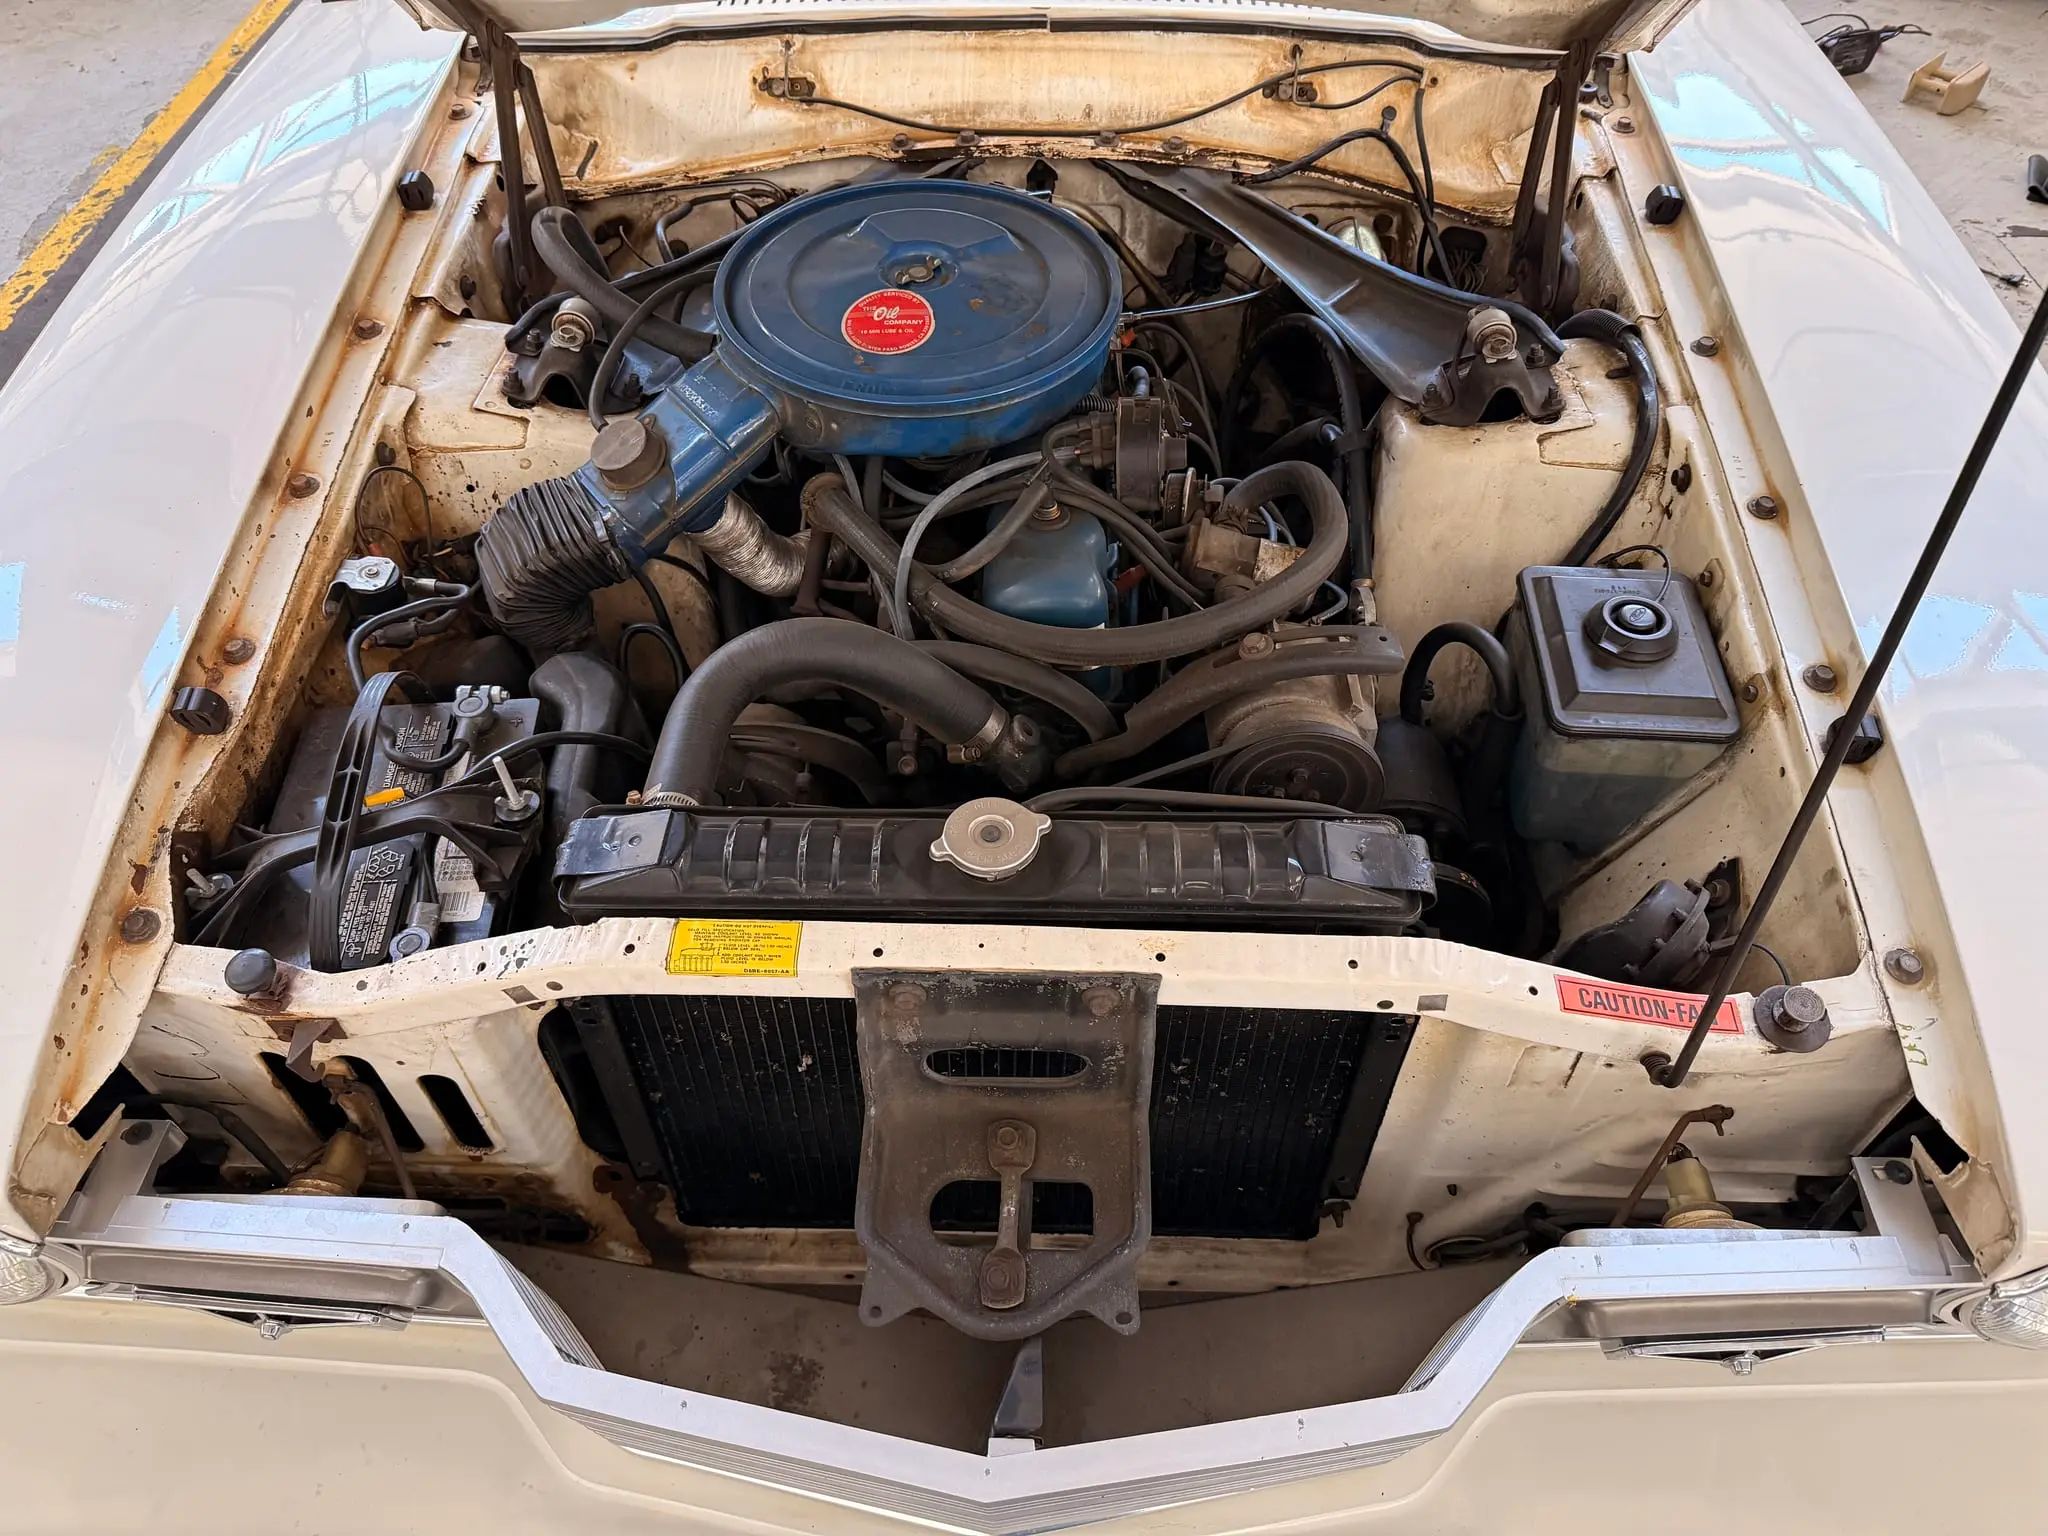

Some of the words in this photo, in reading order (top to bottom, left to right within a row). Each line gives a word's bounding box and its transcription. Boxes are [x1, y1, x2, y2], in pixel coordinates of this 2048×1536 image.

[883, 291, 912, 300] SERVICED
[912, 296, 921, 304] BY
[873, 305, 900, 321] Oil
[1578, 987, 1718, 1026] CAUTION-FA
